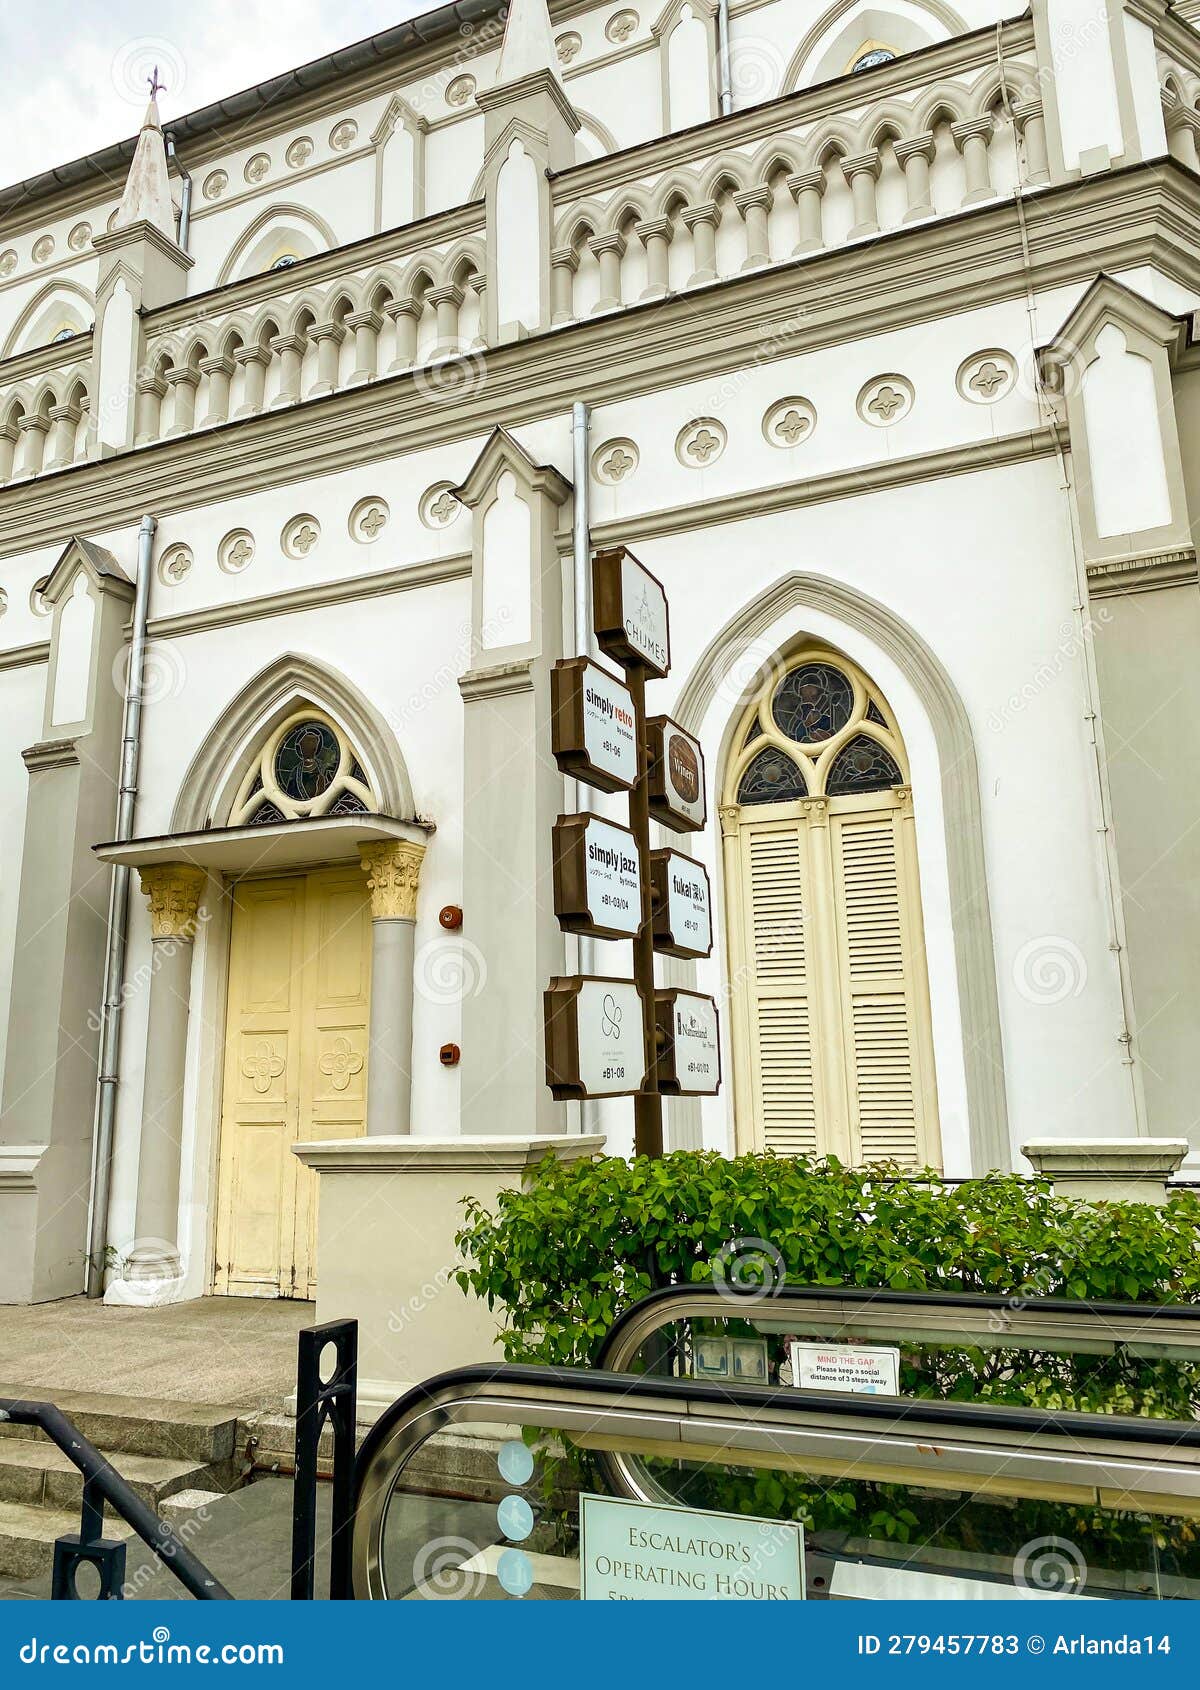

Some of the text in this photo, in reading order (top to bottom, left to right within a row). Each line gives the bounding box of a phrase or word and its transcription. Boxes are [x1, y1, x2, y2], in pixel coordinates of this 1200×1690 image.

[625, 619, 666, 664] CHIJMES
[586, 688, 633, 729] simply retro
[589, 843, 637, 875] simply jazz
[673, 874, 692, 899] fukai
[602, 894, 629, 910] #B1-03/04
[602, 1067, 625, 1079] #B1-08
[817, 1355, 875, 1366] MIND THE GAP
[816, 1365, 838, 1373] Please
[838, 1366, 854, 1375] keep
[860, 1368, 880, 1376] social
[810, 1374, 837, 1382] distance
[851, 1376, 869, 1385] steps
[870, 1378, 887, 1386] away
